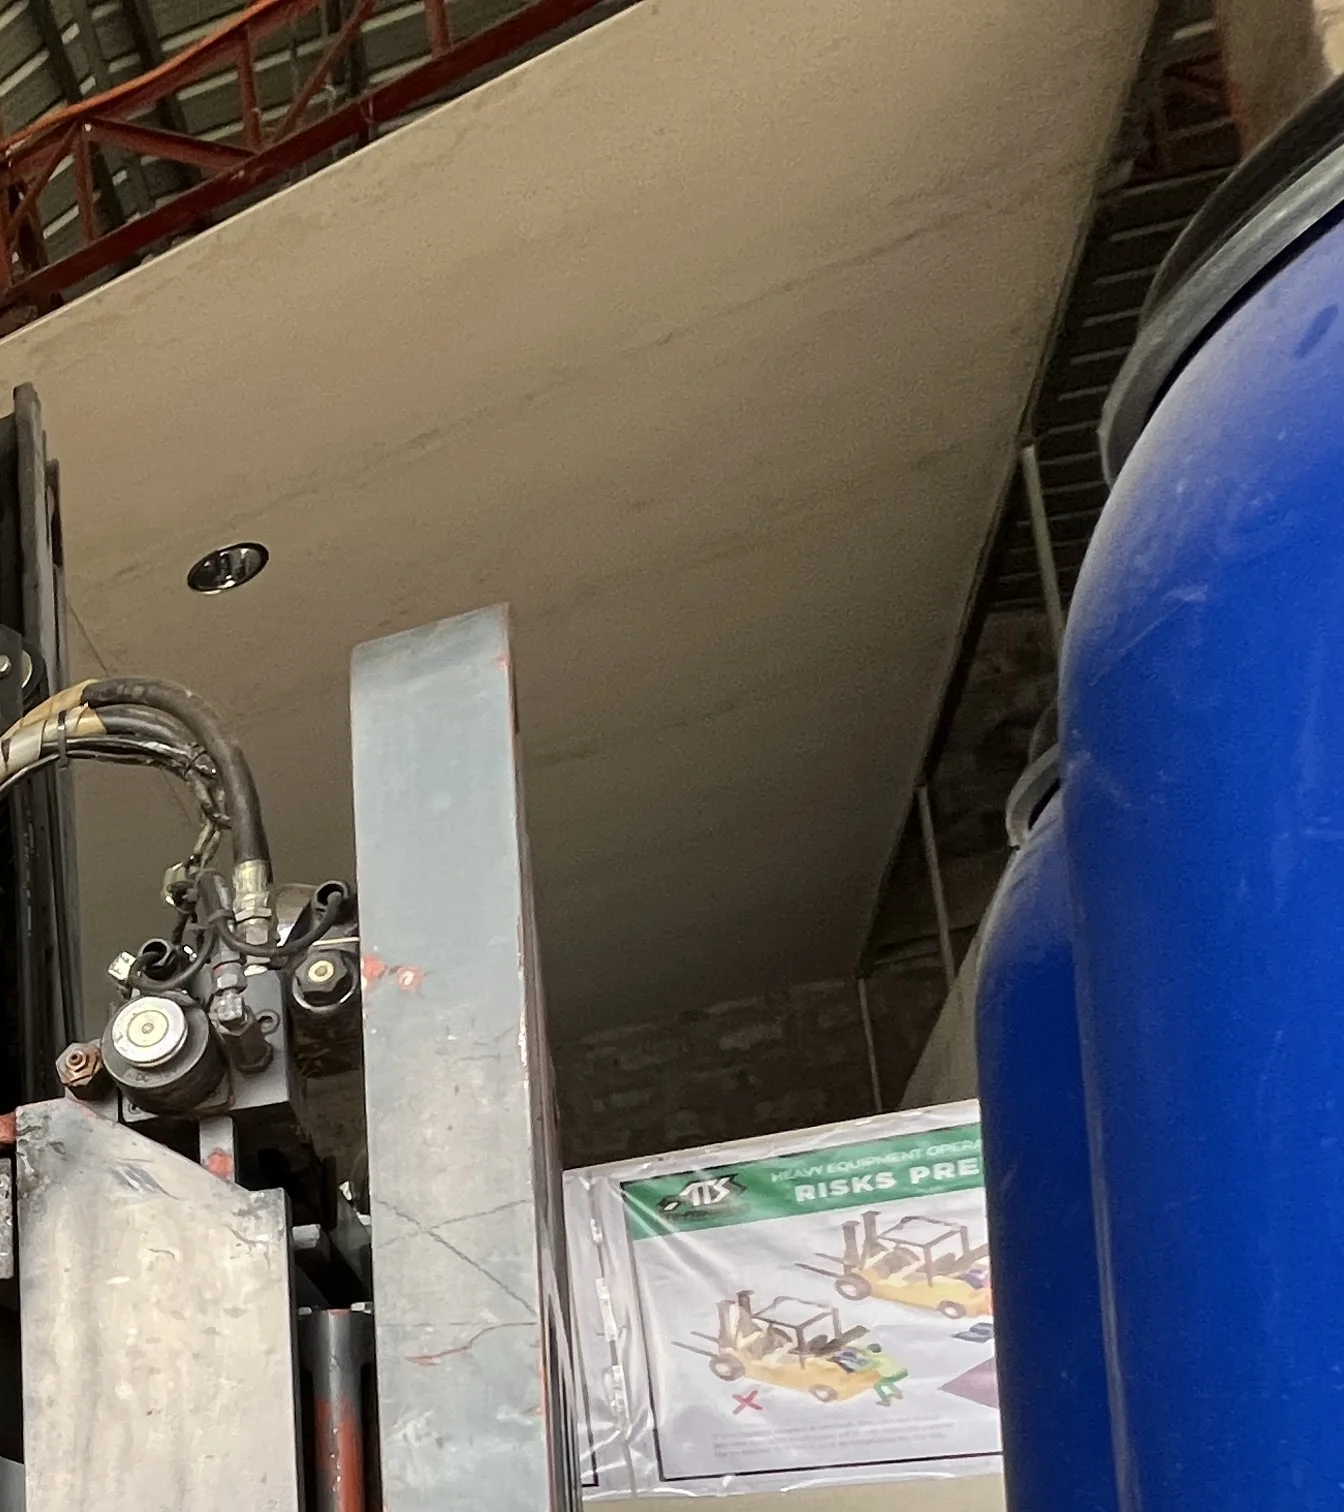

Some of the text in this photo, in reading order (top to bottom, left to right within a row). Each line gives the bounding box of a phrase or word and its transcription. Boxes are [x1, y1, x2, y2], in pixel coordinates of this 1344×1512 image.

[771, 1165, 823, 1183] HEAVY
[827, 1148, 921, 1174] EQUIPMENT
[794, 1157, 980, 1203] RISKS PRE
